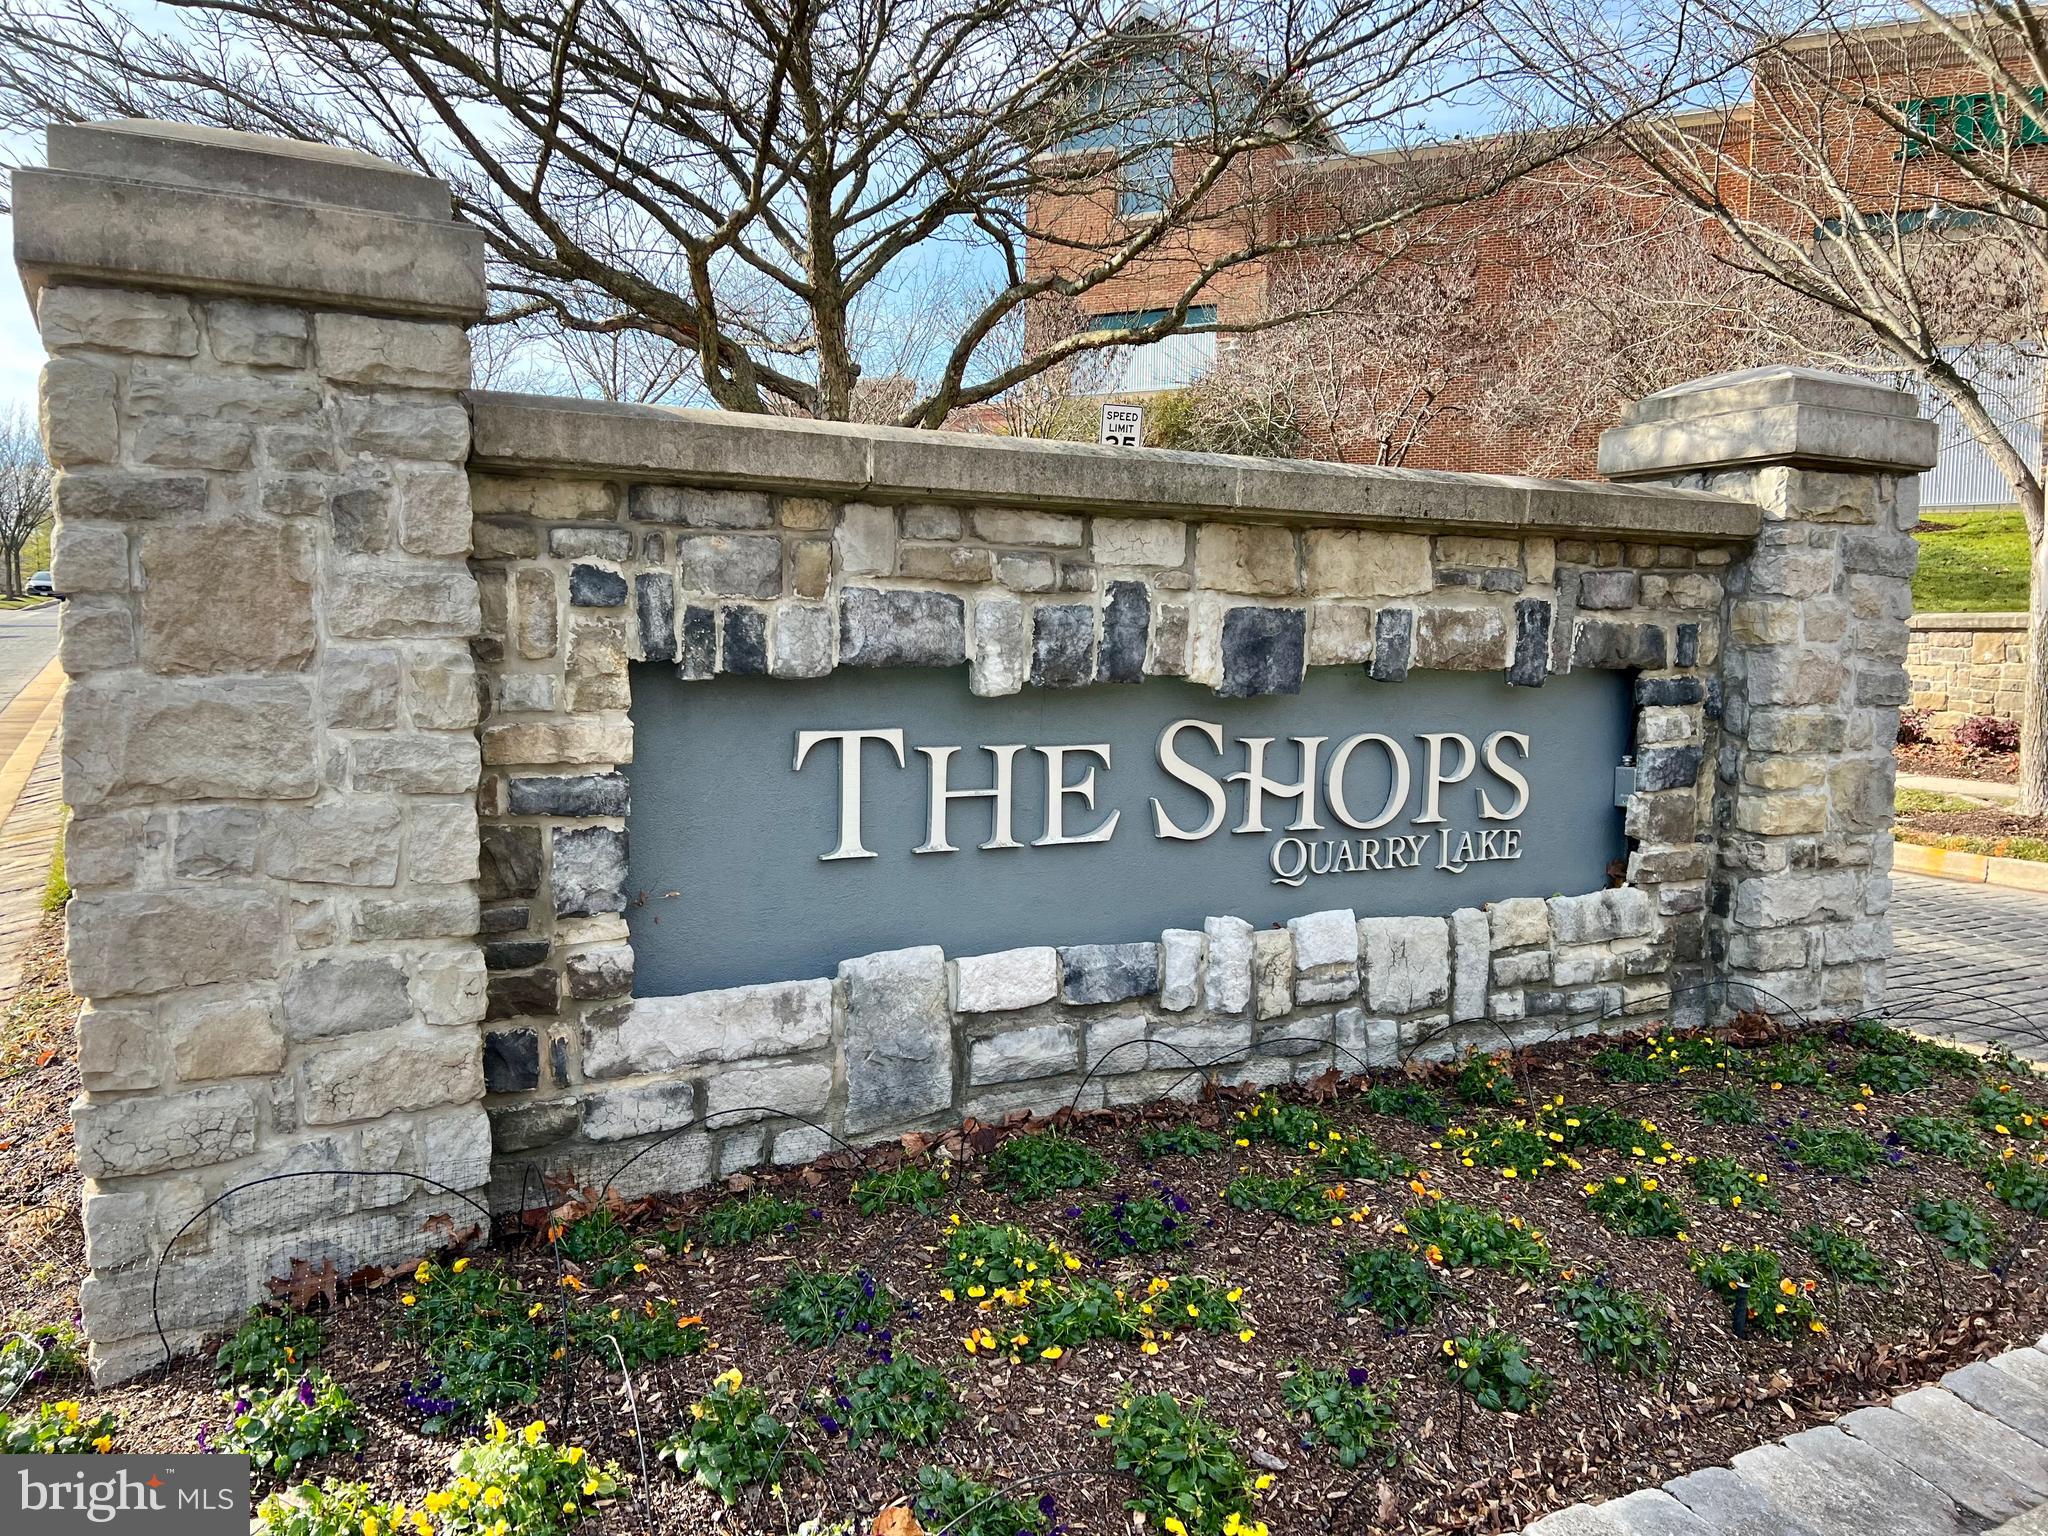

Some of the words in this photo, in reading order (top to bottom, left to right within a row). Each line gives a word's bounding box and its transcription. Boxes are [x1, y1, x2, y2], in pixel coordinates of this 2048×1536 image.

[1106, 411, 1138, 421] SPEED
[1108, 423, 1134, 433] LIMIT
[792, 728, 1121, 861] THE
[1149, 719, 1530, 841] SHOPS
[1269, 834, 1430, 887] QUARRY
[1434, 828, 1523, 874] LAKE
